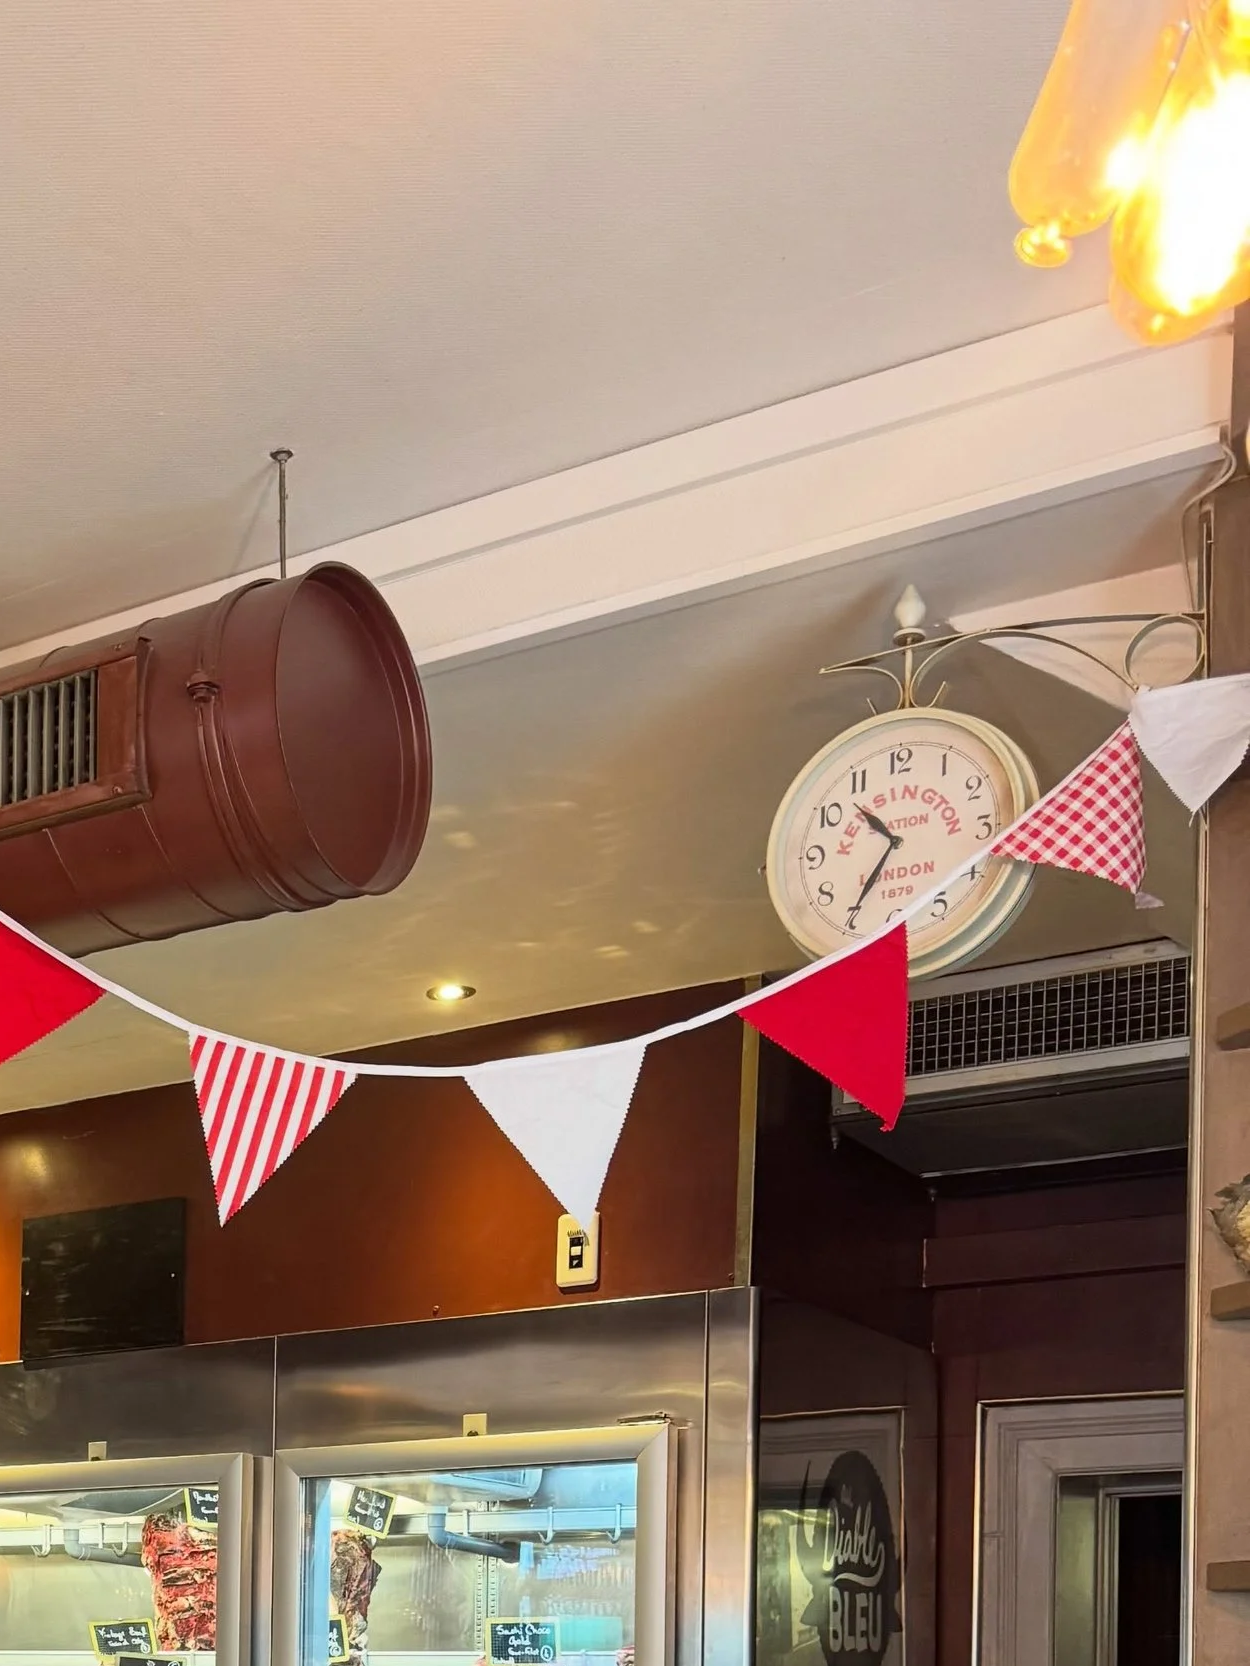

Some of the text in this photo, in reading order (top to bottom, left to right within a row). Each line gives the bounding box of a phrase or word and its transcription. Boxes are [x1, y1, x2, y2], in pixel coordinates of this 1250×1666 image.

[889, 748, 913, 775] 12
[941, 752, 948, 777] 1
[851, 769, 867, 794] 11
[965, 775, 982, 801] 2
[820, 802, 842, 828] 10
[837, 785, 962, 855] KENSINGTON
[868, 813, 929, 835] ATION
[975, 814, 992, 840] 3
[806, 845, 825, 870] 9
[817, 881, 834, 906] 8
[882, 885, 914, 899] 1879
[931, 891, 948, 917] 5
[846, 905, 862, 930] 7
[829, 1586, 884, 1652] BLEU
